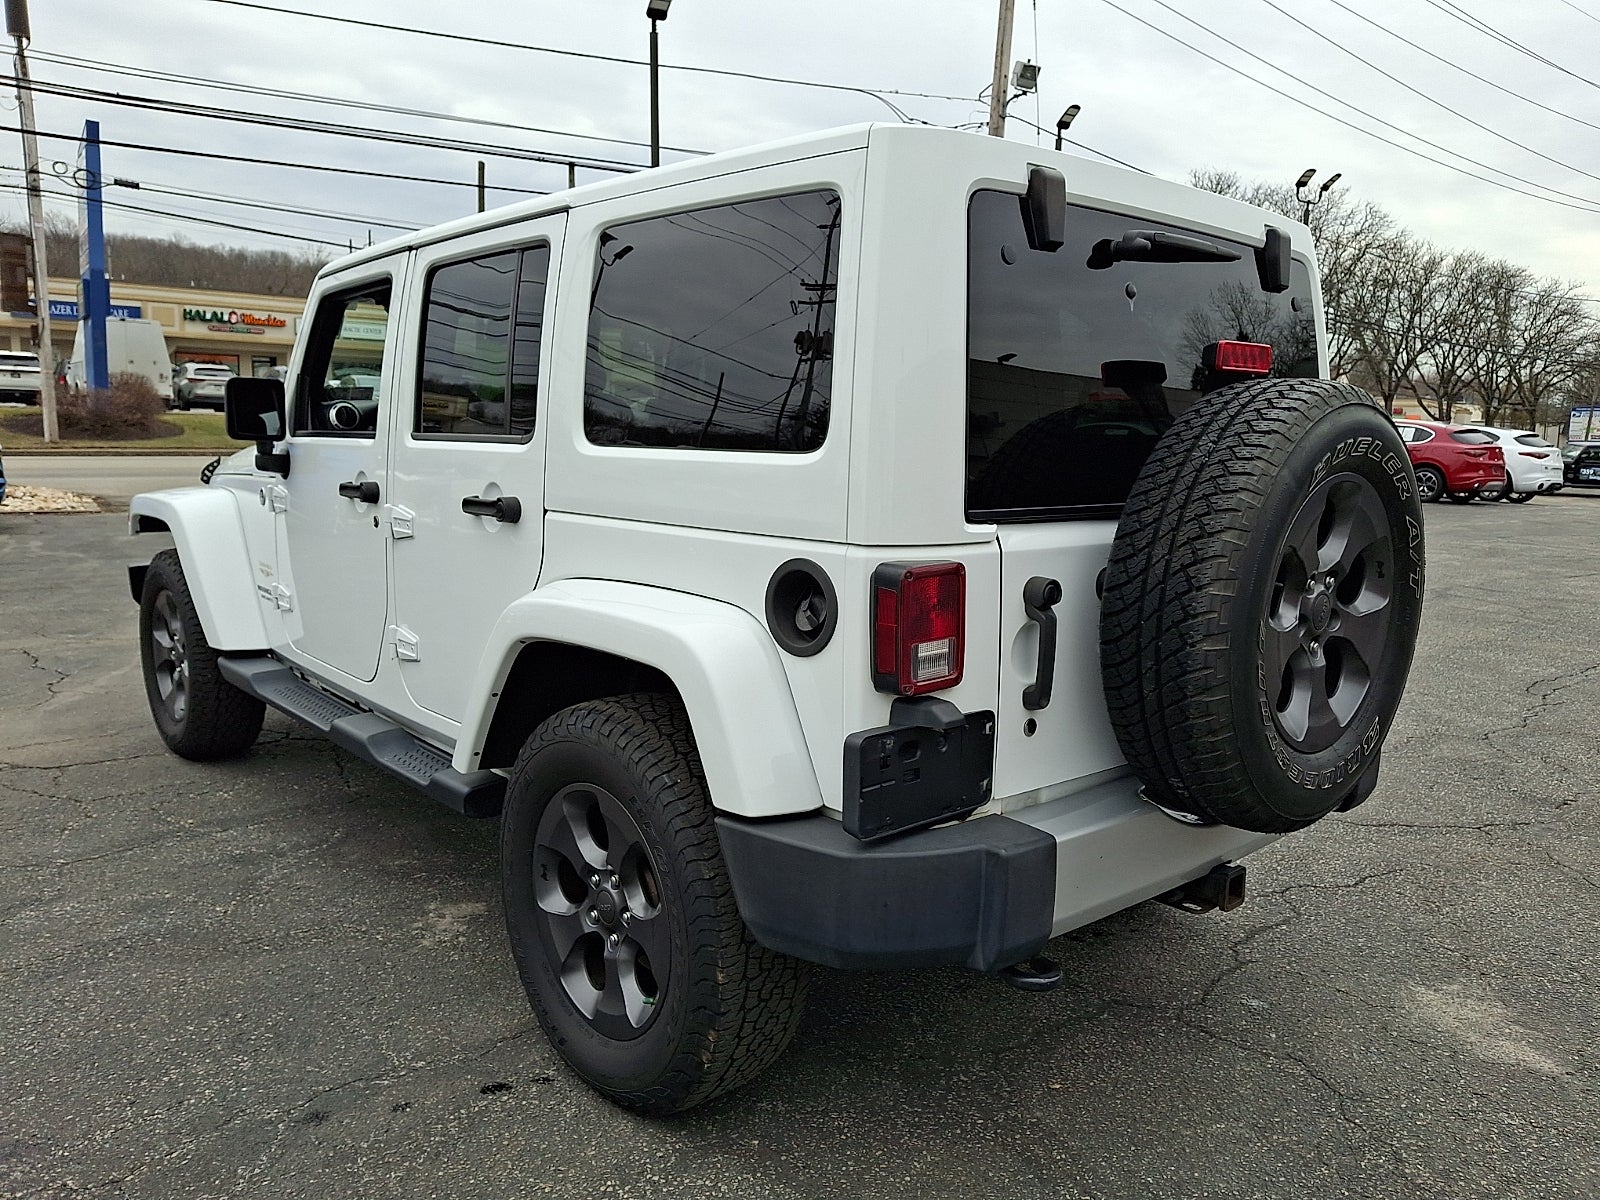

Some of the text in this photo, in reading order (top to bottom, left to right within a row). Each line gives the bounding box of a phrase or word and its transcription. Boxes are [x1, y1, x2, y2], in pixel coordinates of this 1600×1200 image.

[49, 304, 71, 315] AZER
[110, 308, 129, 318] ARE
[183, 308, 229, 323] HALAL
[1309, 436, 1423, 600] DUELER A/T
